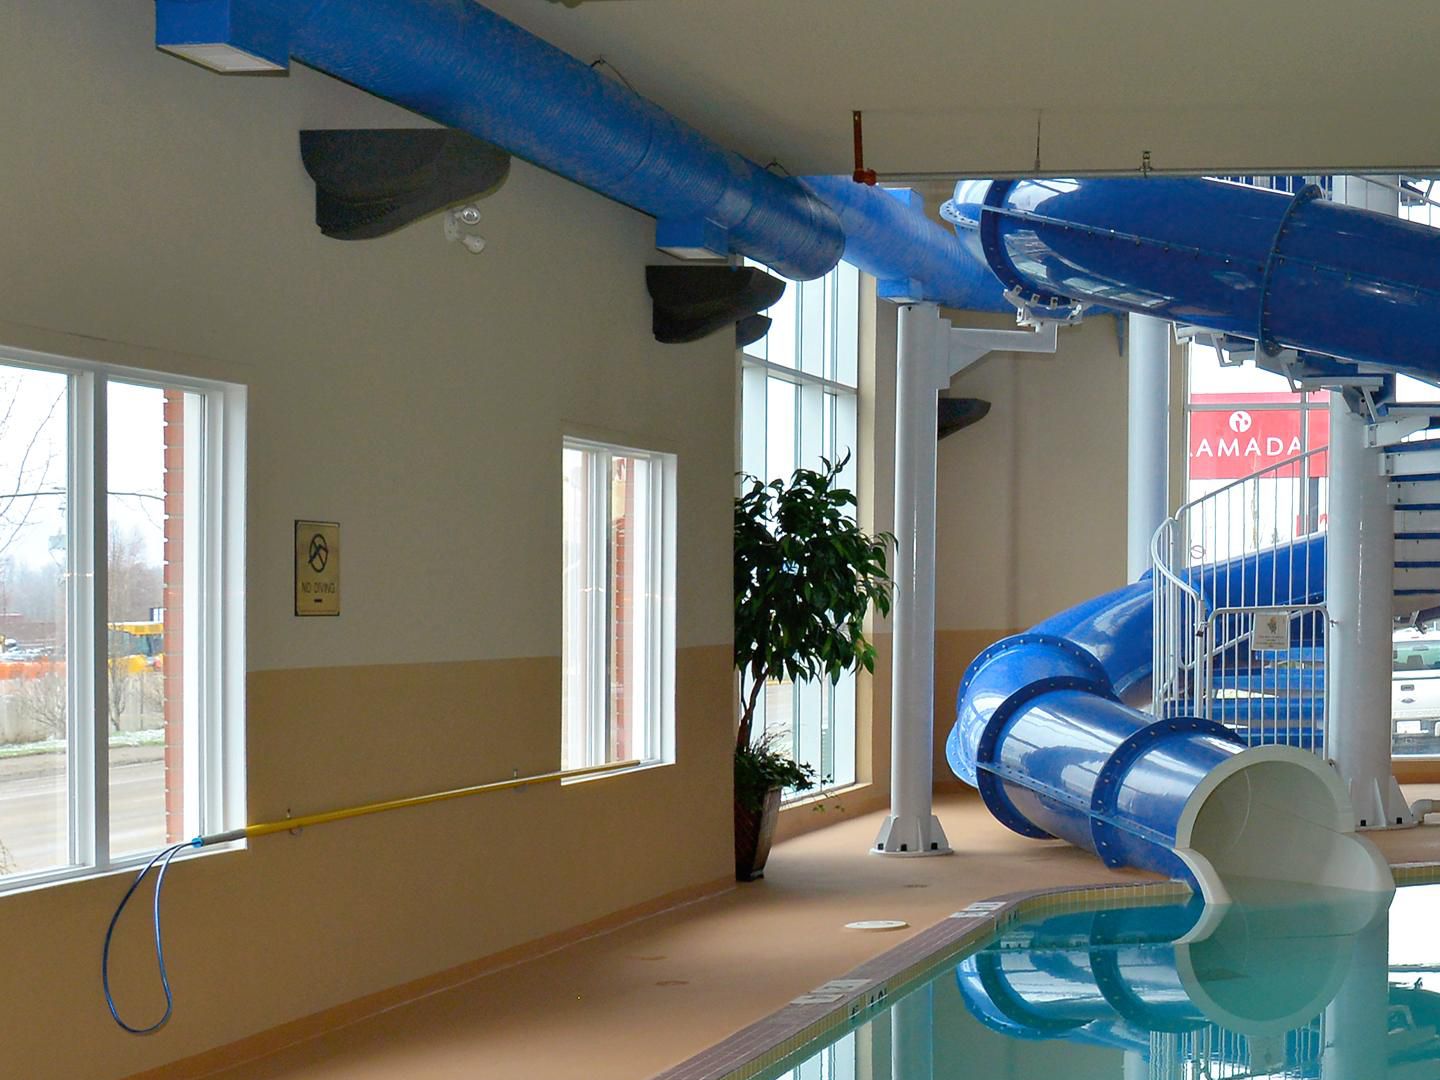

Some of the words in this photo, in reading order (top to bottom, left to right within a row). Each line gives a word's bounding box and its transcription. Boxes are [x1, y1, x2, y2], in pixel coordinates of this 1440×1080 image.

[1190, 437, 1301, 457] AMADA
[301, 581, 311, 594] NO
[314, 581, 336, 594] DIVING
